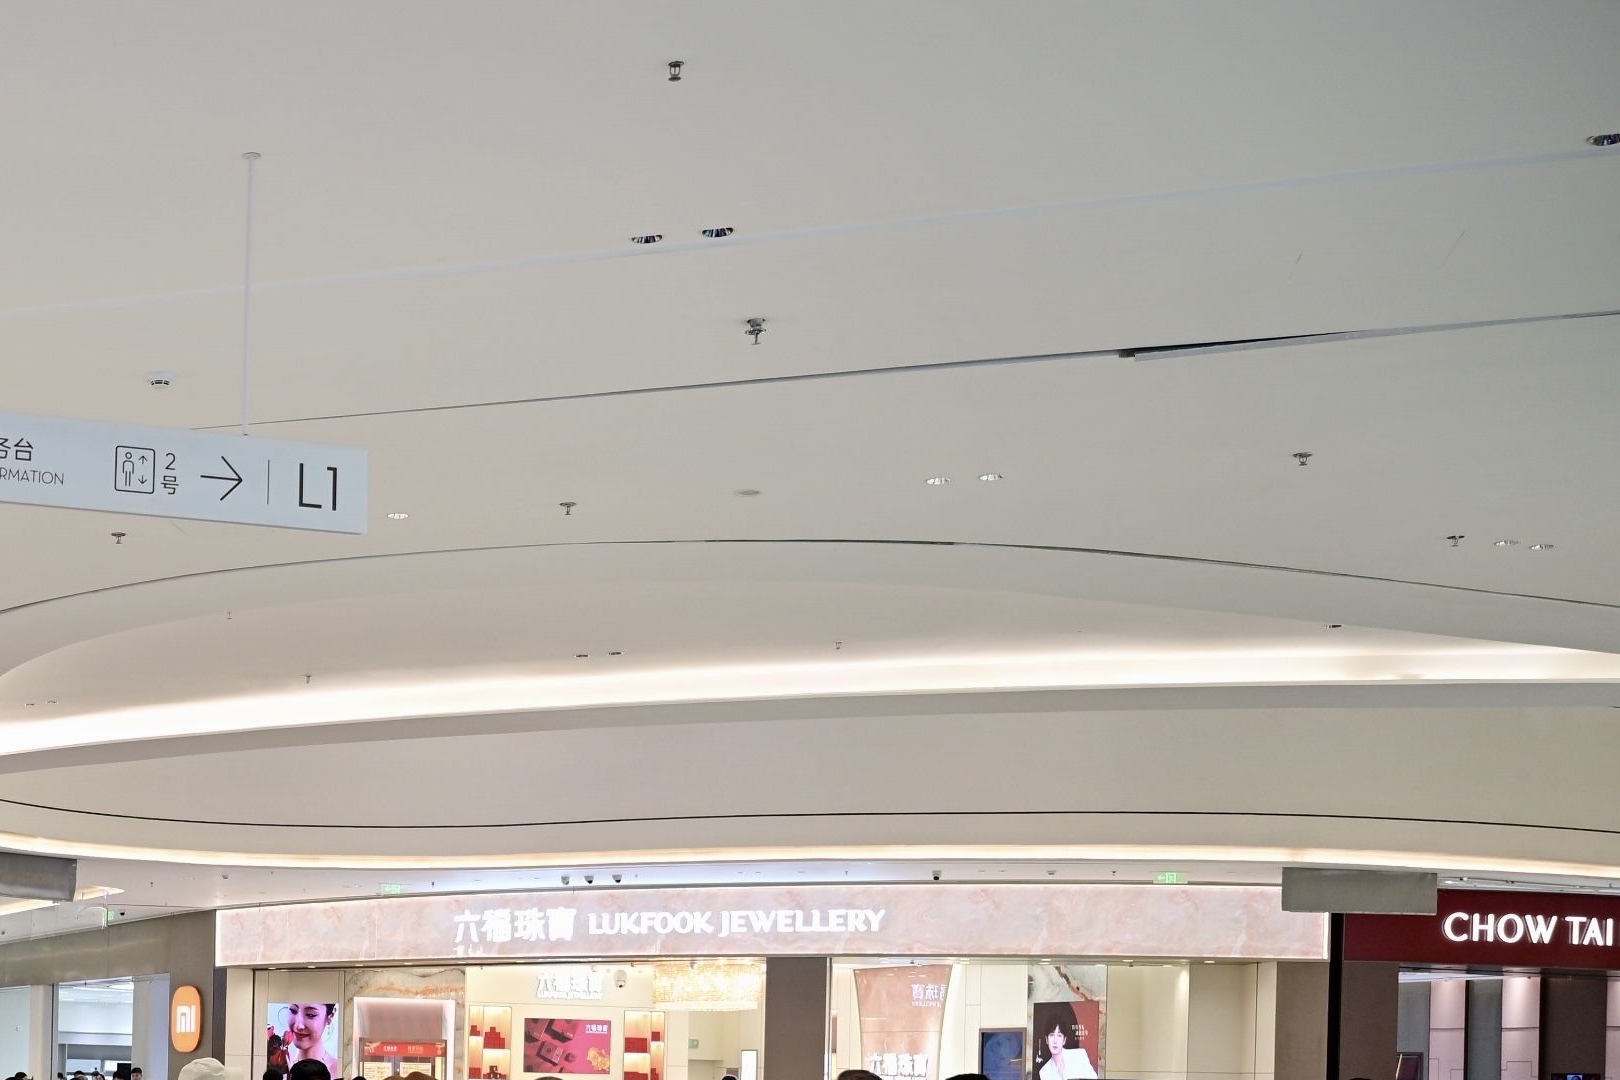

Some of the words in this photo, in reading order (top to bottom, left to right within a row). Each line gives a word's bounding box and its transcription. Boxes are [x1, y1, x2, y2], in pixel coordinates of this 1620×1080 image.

[298, 462, 338, 512] L1
[587, 910, 715, 936] LUKFOOK
[718, 908, 887, 938] JEWELLERY
[1443, 911, 1558, 944] CHOW
[1564, 916, 1615, 947] TAI
